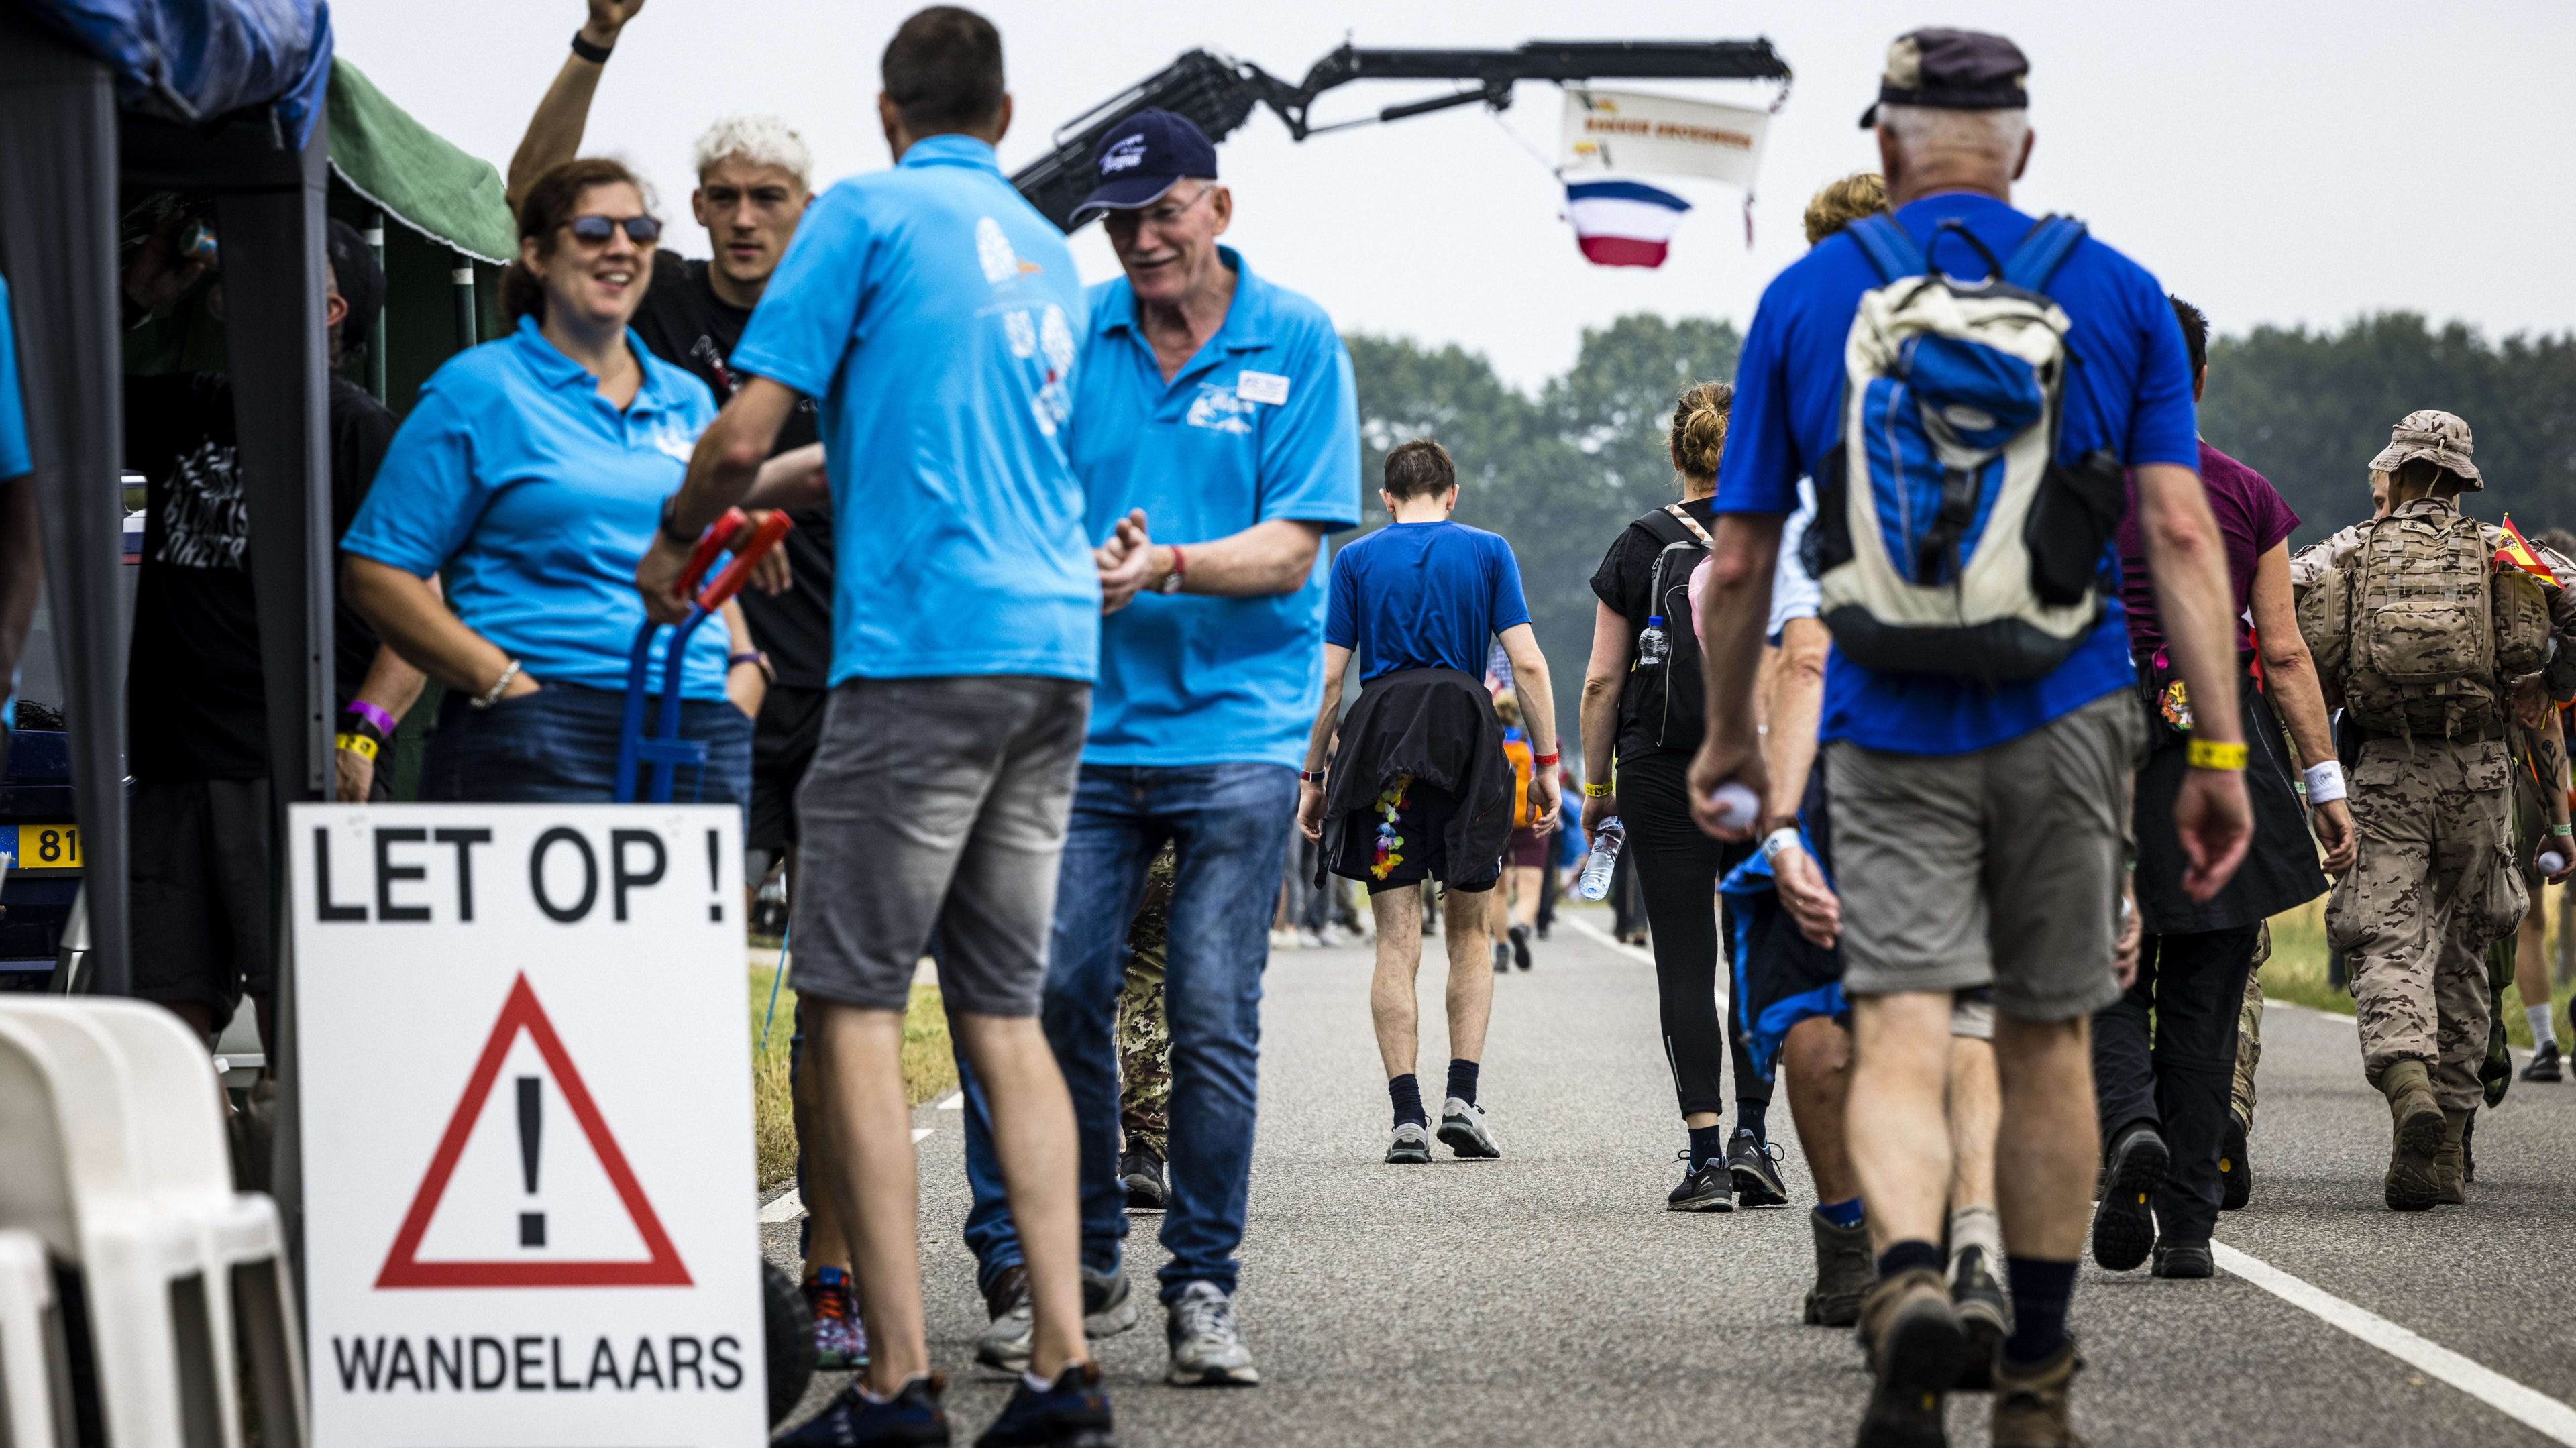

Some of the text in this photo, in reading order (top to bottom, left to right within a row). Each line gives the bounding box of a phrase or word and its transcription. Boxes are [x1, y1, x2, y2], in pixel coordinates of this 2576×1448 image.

[39, 830, 76, 862] 81
[313, 826, 724, 924] LET OP !
[332, 1336, 745, 1392] WANDELAARS
